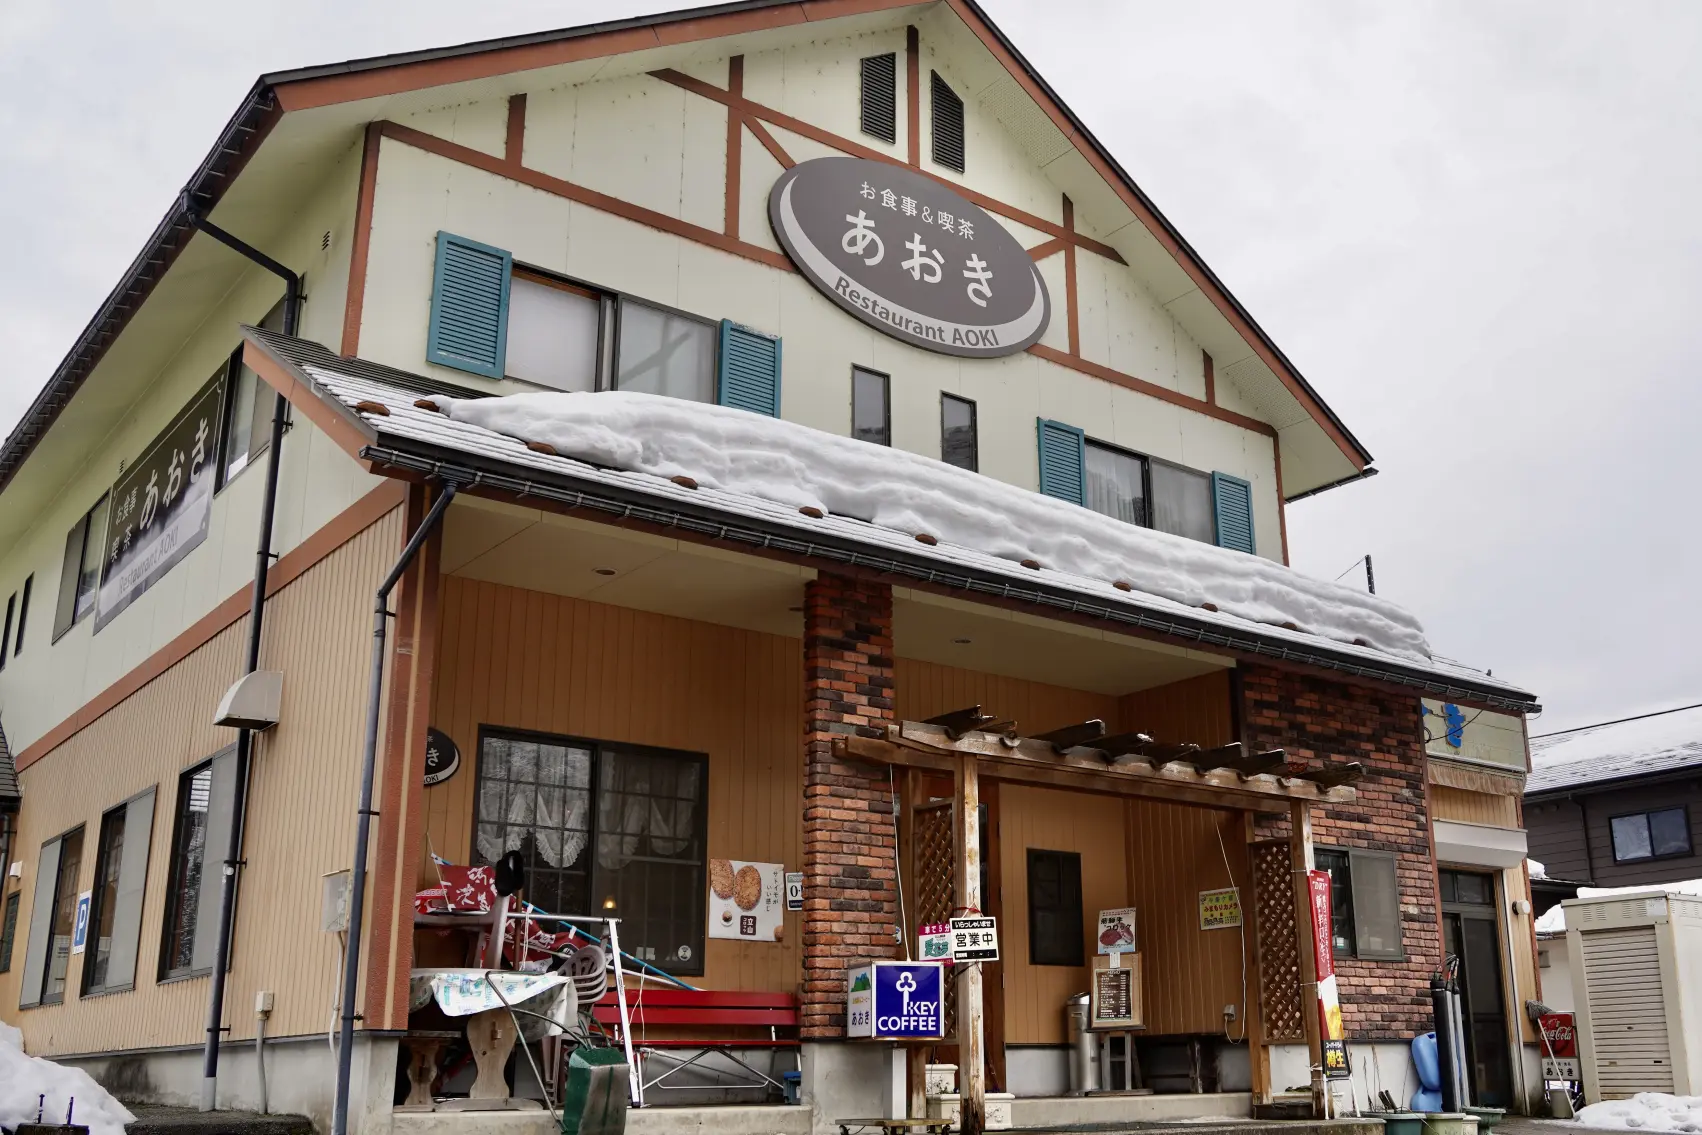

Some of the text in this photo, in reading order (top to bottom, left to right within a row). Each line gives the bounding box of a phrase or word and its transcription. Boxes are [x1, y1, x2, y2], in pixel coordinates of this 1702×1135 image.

[859, 181, 975, 241] お食事&喫茶
[841, 209, 994, 308] あおき
[834, 275, 999, 347] Restaurant AOKI
[139, 417, 209, 531] あおき
[115, 486, 138, 526] お食事
[117, 526, 179, 595] Restaurant AOKI
[77, 903, 87, 941] P
[747, 917, 754, 934] 立山
[954, 920, 991, 928] いらっしゃいませ
[955, 931, 993, 947] 営業中
[852, 1010, 869, 1026] あおき
[907, 1001, 938, 1016] KEY
[877, 1016, 937, 1031] COFFEE
[1326, 1049, 1345, 1068] 樽生
[1546, 1067, 1573, 1077] あおき
